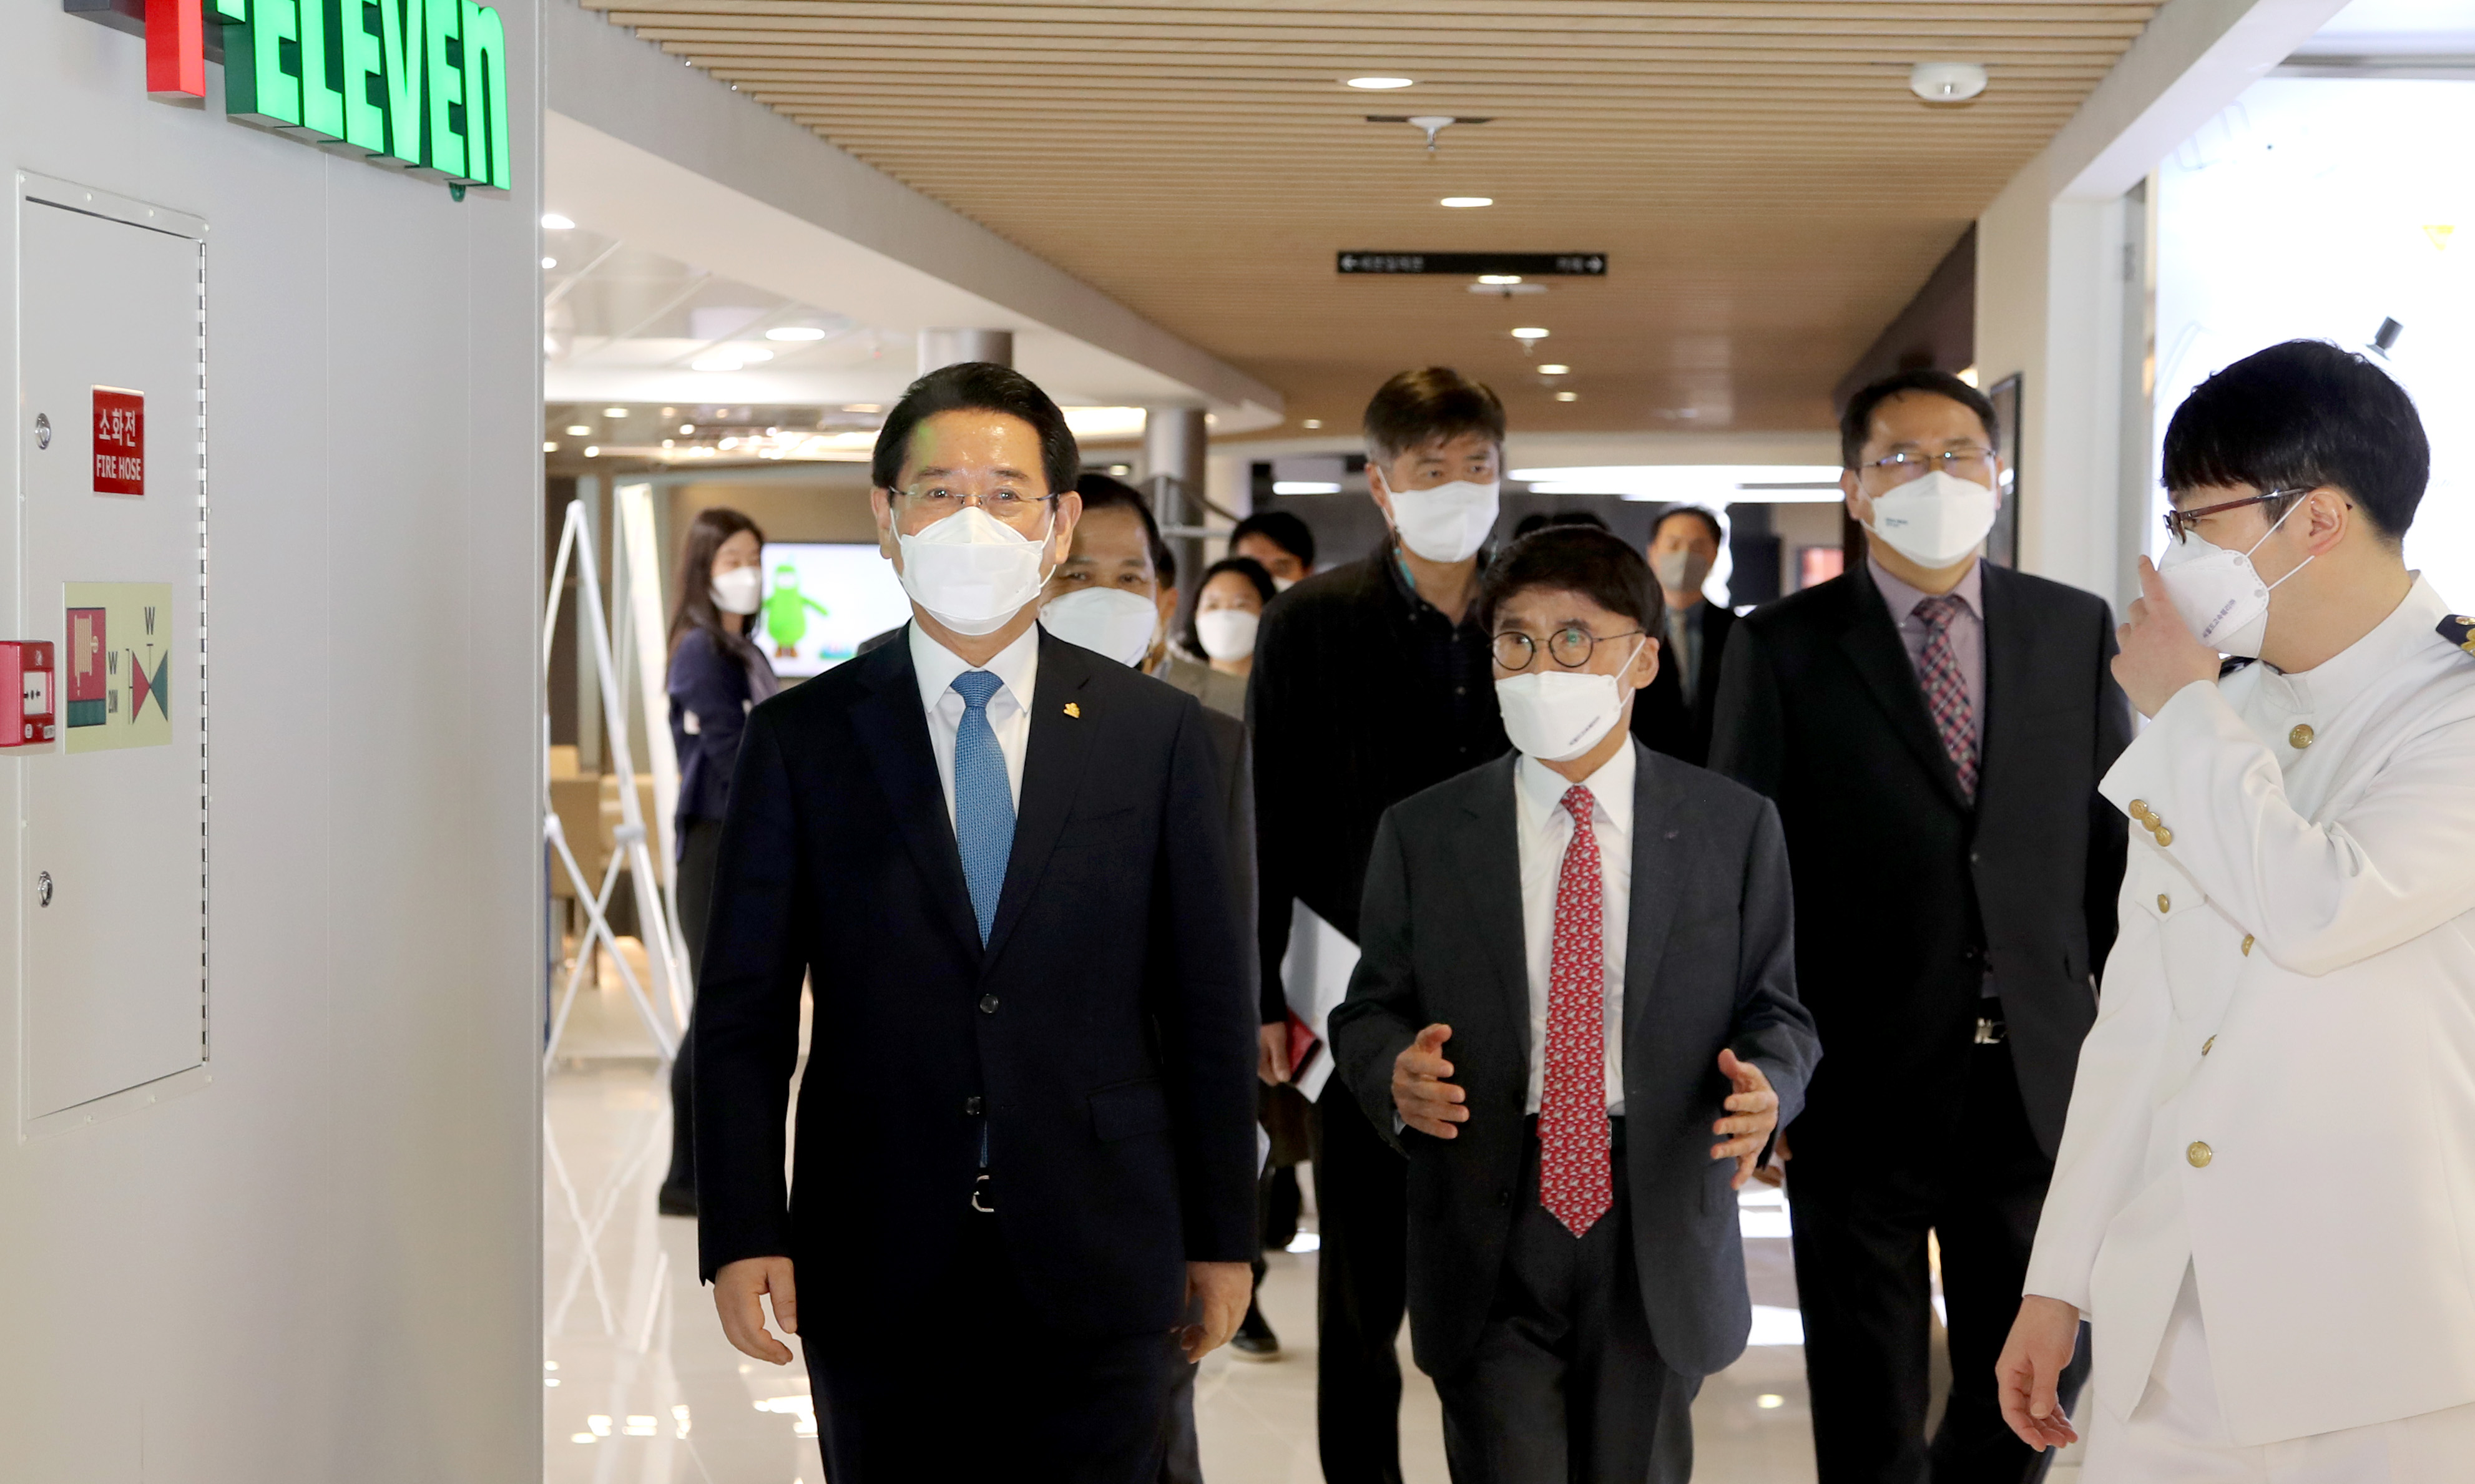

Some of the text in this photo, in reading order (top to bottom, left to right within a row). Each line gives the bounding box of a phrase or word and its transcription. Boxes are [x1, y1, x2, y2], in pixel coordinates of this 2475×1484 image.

[99, 408, 136, 447] 소화전
[96, 454, 141, 481] FIRE HOSE
[144, 607, 155, 635] W
[108, 651, 118, 675] W
